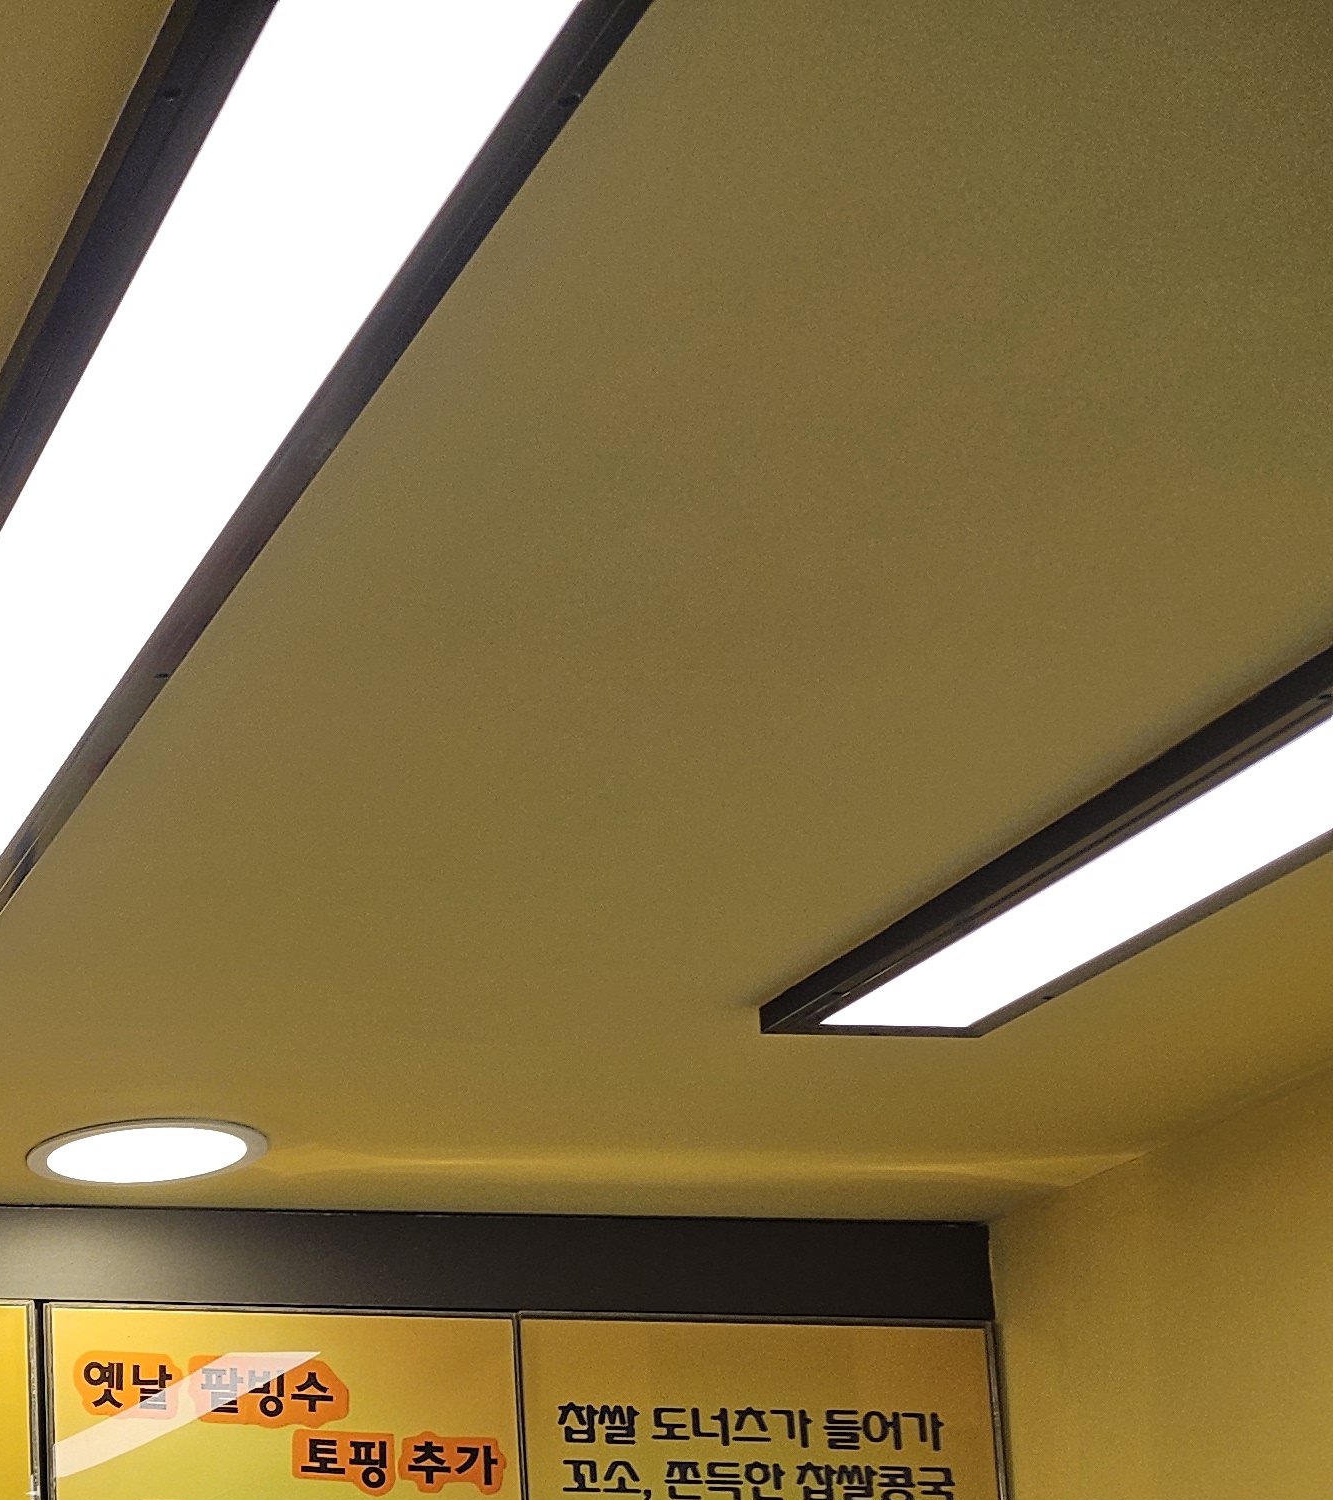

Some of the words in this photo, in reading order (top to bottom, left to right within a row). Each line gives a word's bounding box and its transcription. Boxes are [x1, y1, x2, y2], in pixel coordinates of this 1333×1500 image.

[83, 1361, 173, 1410] 옛날
[201, 1367, 334, 1418] 팥빙수
[558, 1402, 640, 1445] 찹쌀
[651, 1406, 813, 1449] 도너츠가
[822, 1409, 945, 1451] 들어가
[301, 1437, 388, 1489] 토핑
[408, 1441, 499, 1486] 추가
